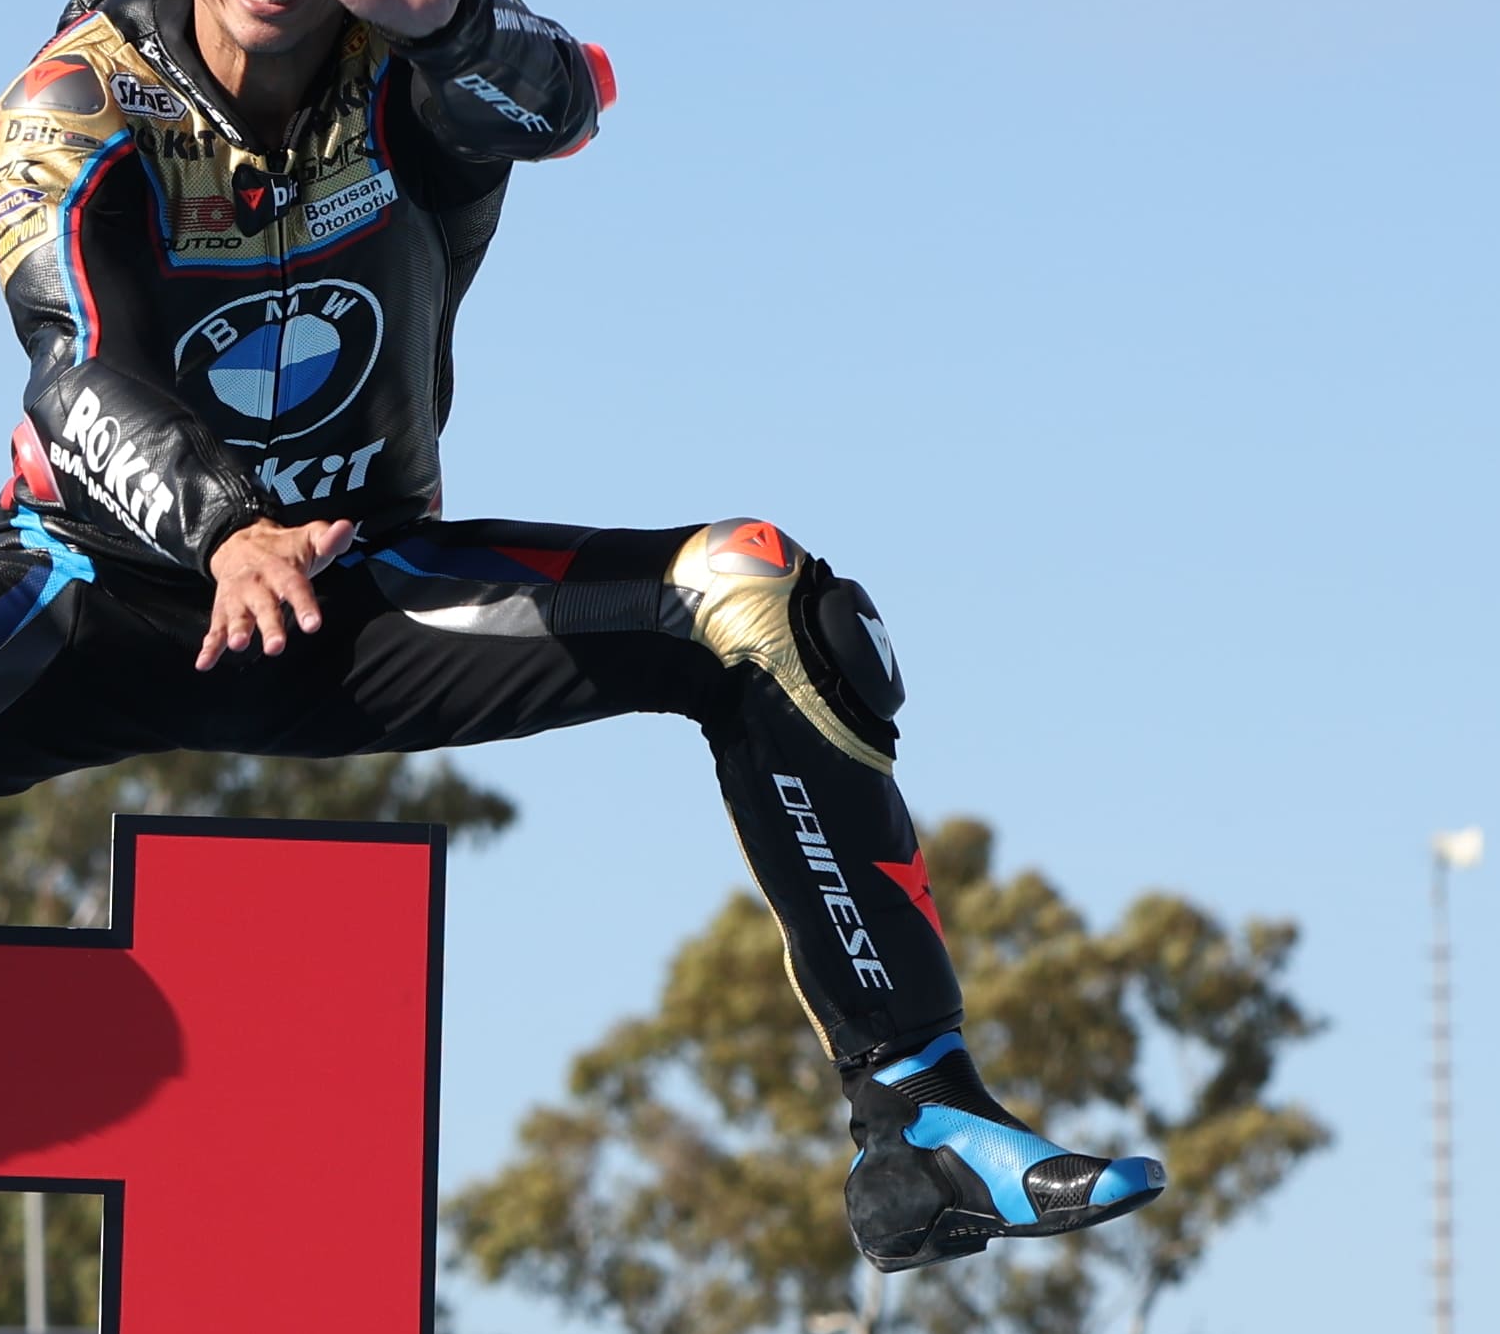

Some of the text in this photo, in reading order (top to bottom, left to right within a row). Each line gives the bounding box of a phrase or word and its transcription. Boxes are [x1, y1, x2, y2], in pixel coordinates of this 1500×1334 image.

[305, 178, 382, 221] Borusan
[312, 189, 394, 238] Otomotiv
[201, 291, 359, 353] BMW
[771, 772, 894, 992] DAINESE
